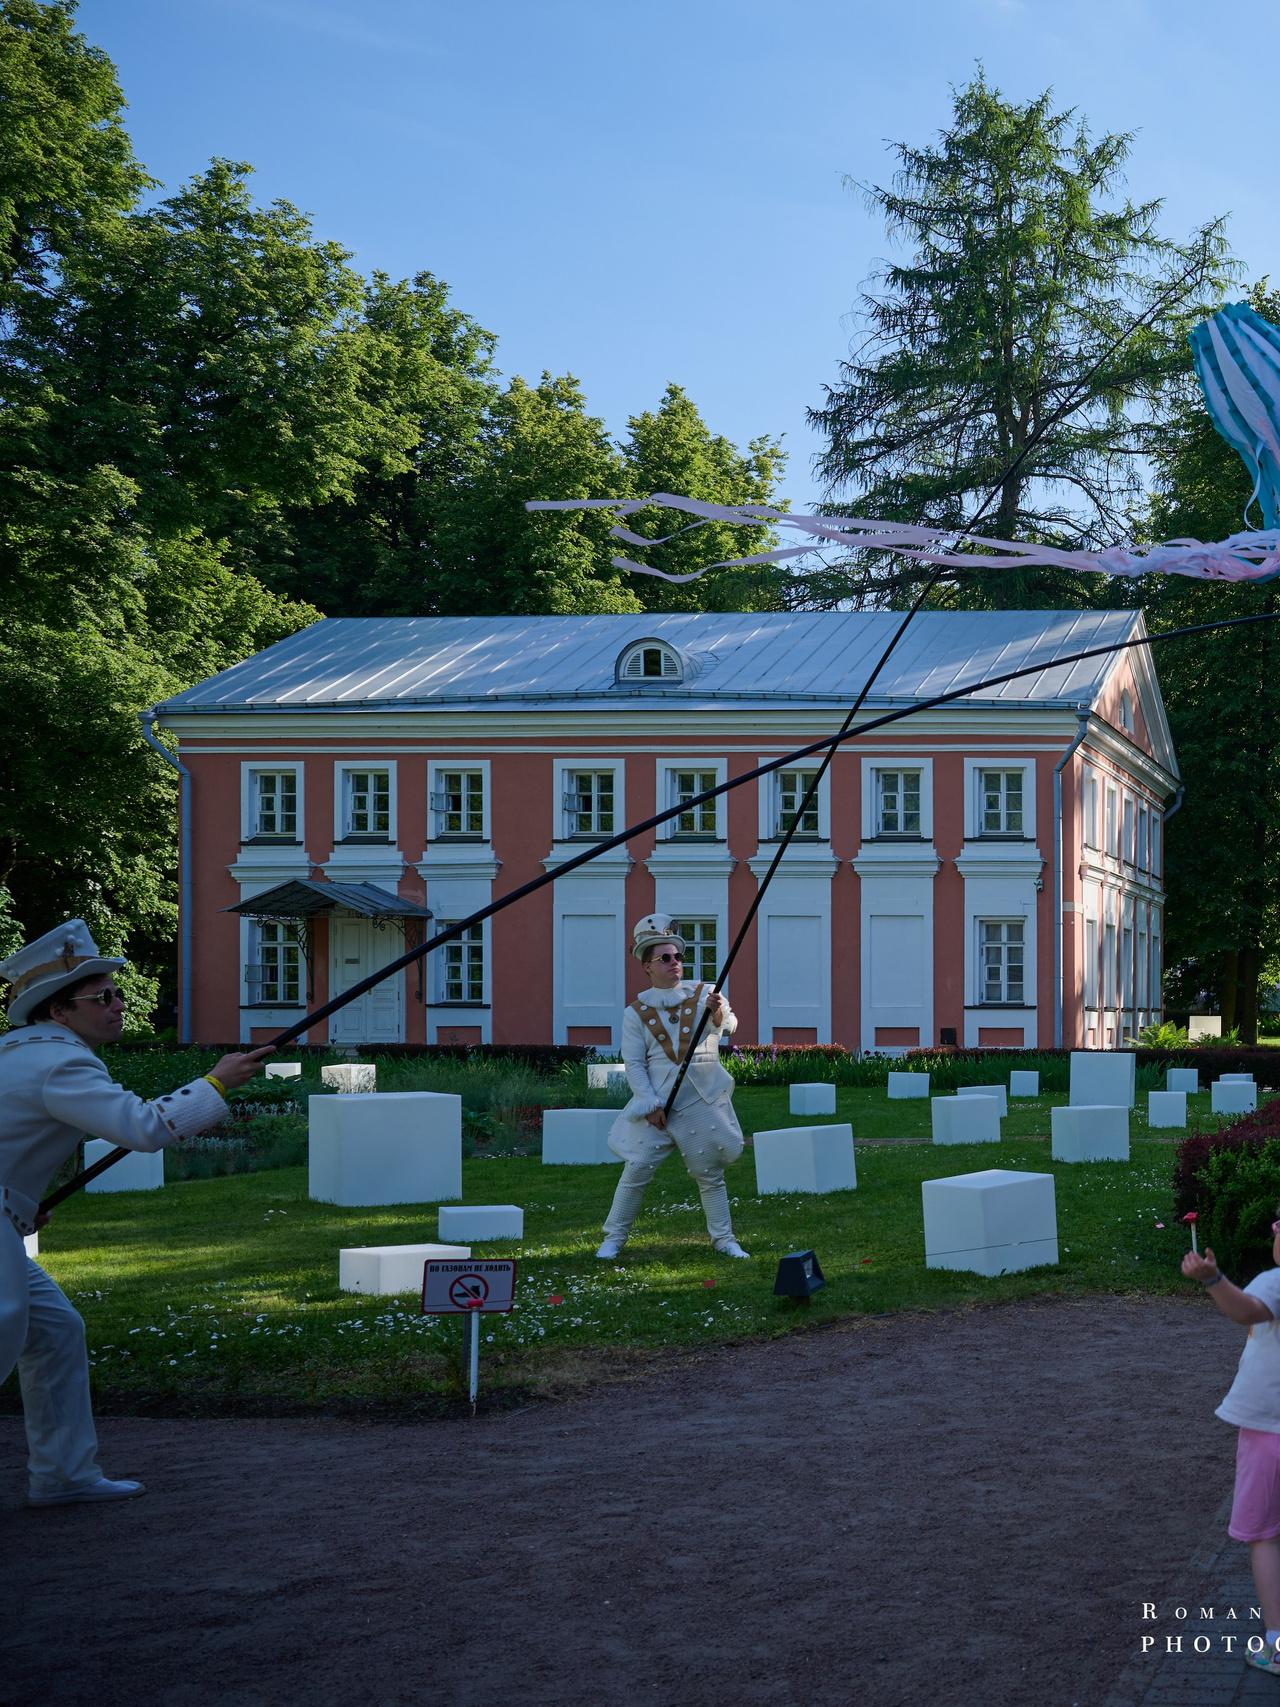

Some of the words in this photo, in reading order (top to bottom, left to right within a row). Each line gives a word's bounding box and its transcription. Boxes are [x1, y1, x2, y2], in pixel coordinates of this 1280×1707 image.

[441, 1264, 473, 1272] ГАЗОНАМ
[474, 1264, 483, 1272] НЕ
[484, 1264, 511, 1272] ХОДИТЬ
